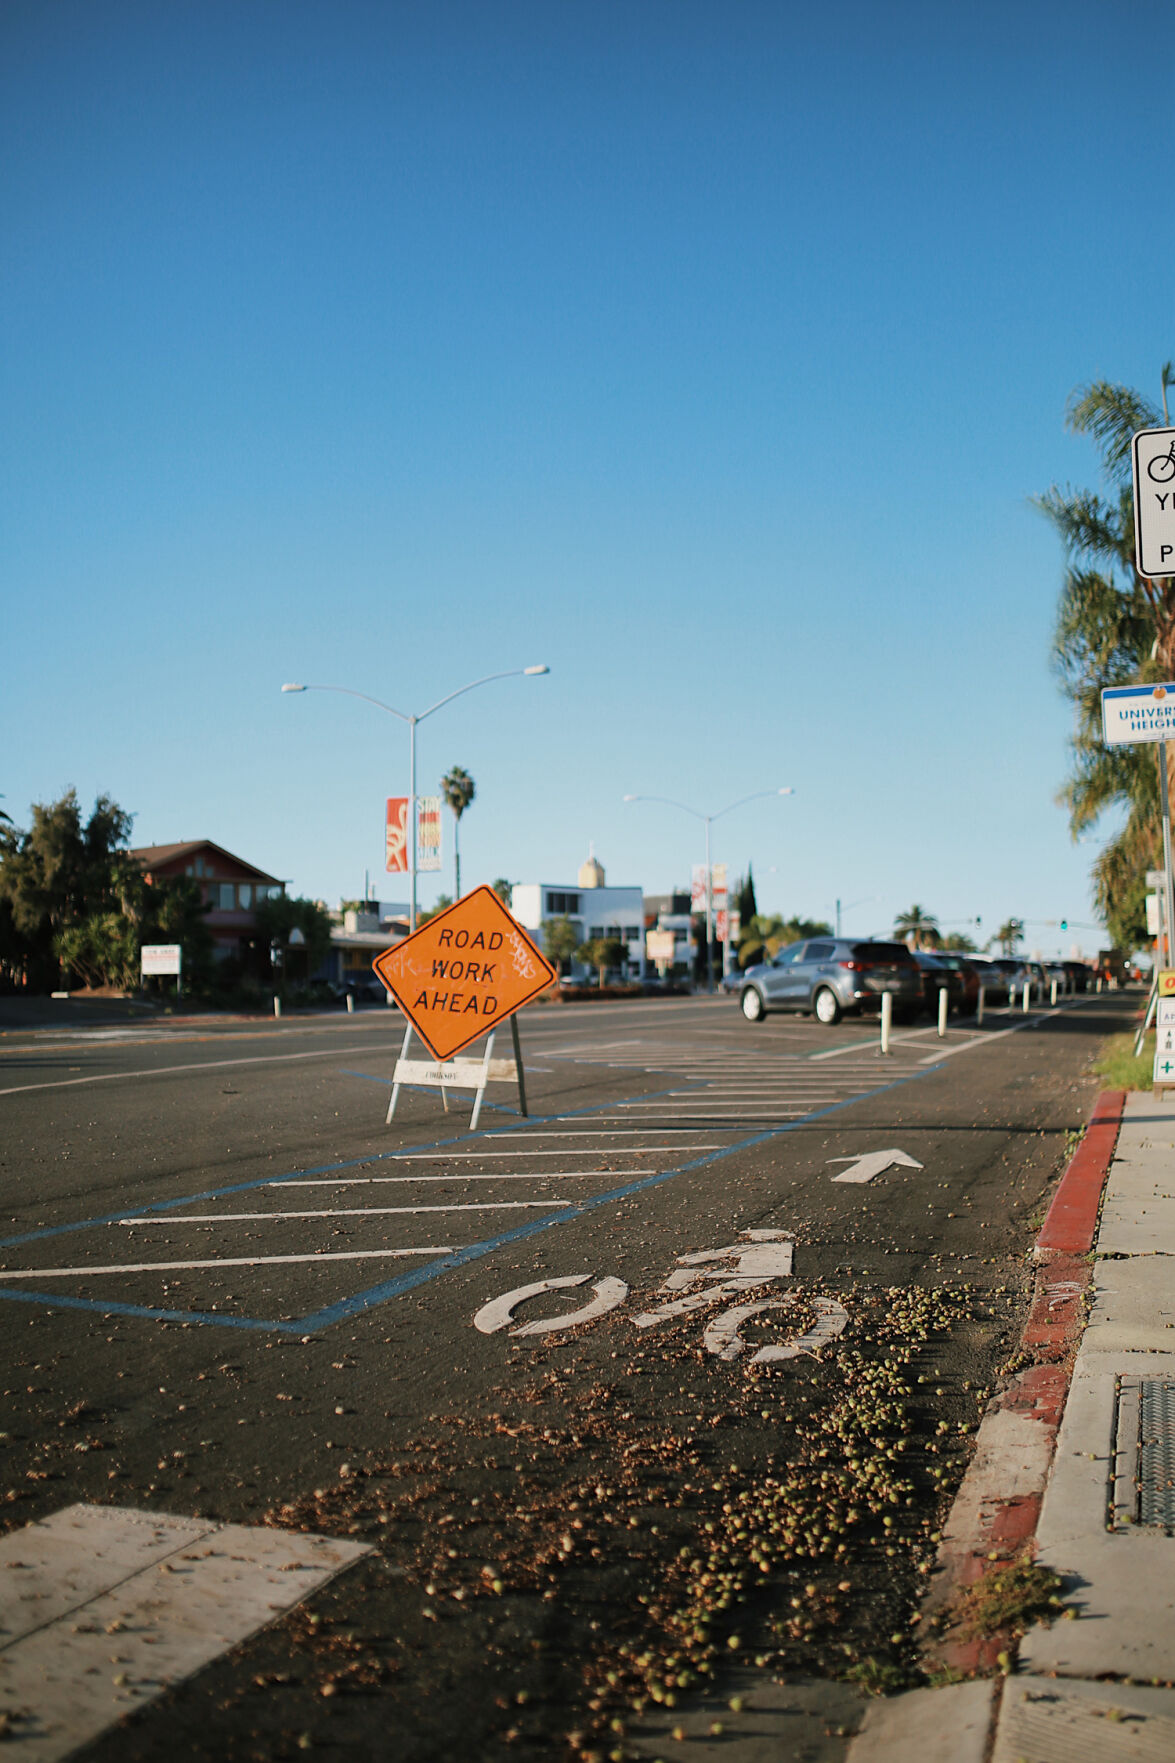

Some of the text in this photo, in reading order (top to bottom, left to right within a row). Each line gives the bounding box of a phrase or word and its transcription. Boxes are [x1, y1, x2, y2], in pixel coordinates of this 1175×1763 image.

[1119, 706, 1175, 720] UNIVER
[438, 928, 504, 951] ROAD
[431, 959, 497, 983] WORK
[412, 990, 498, 1016] AHEAD
